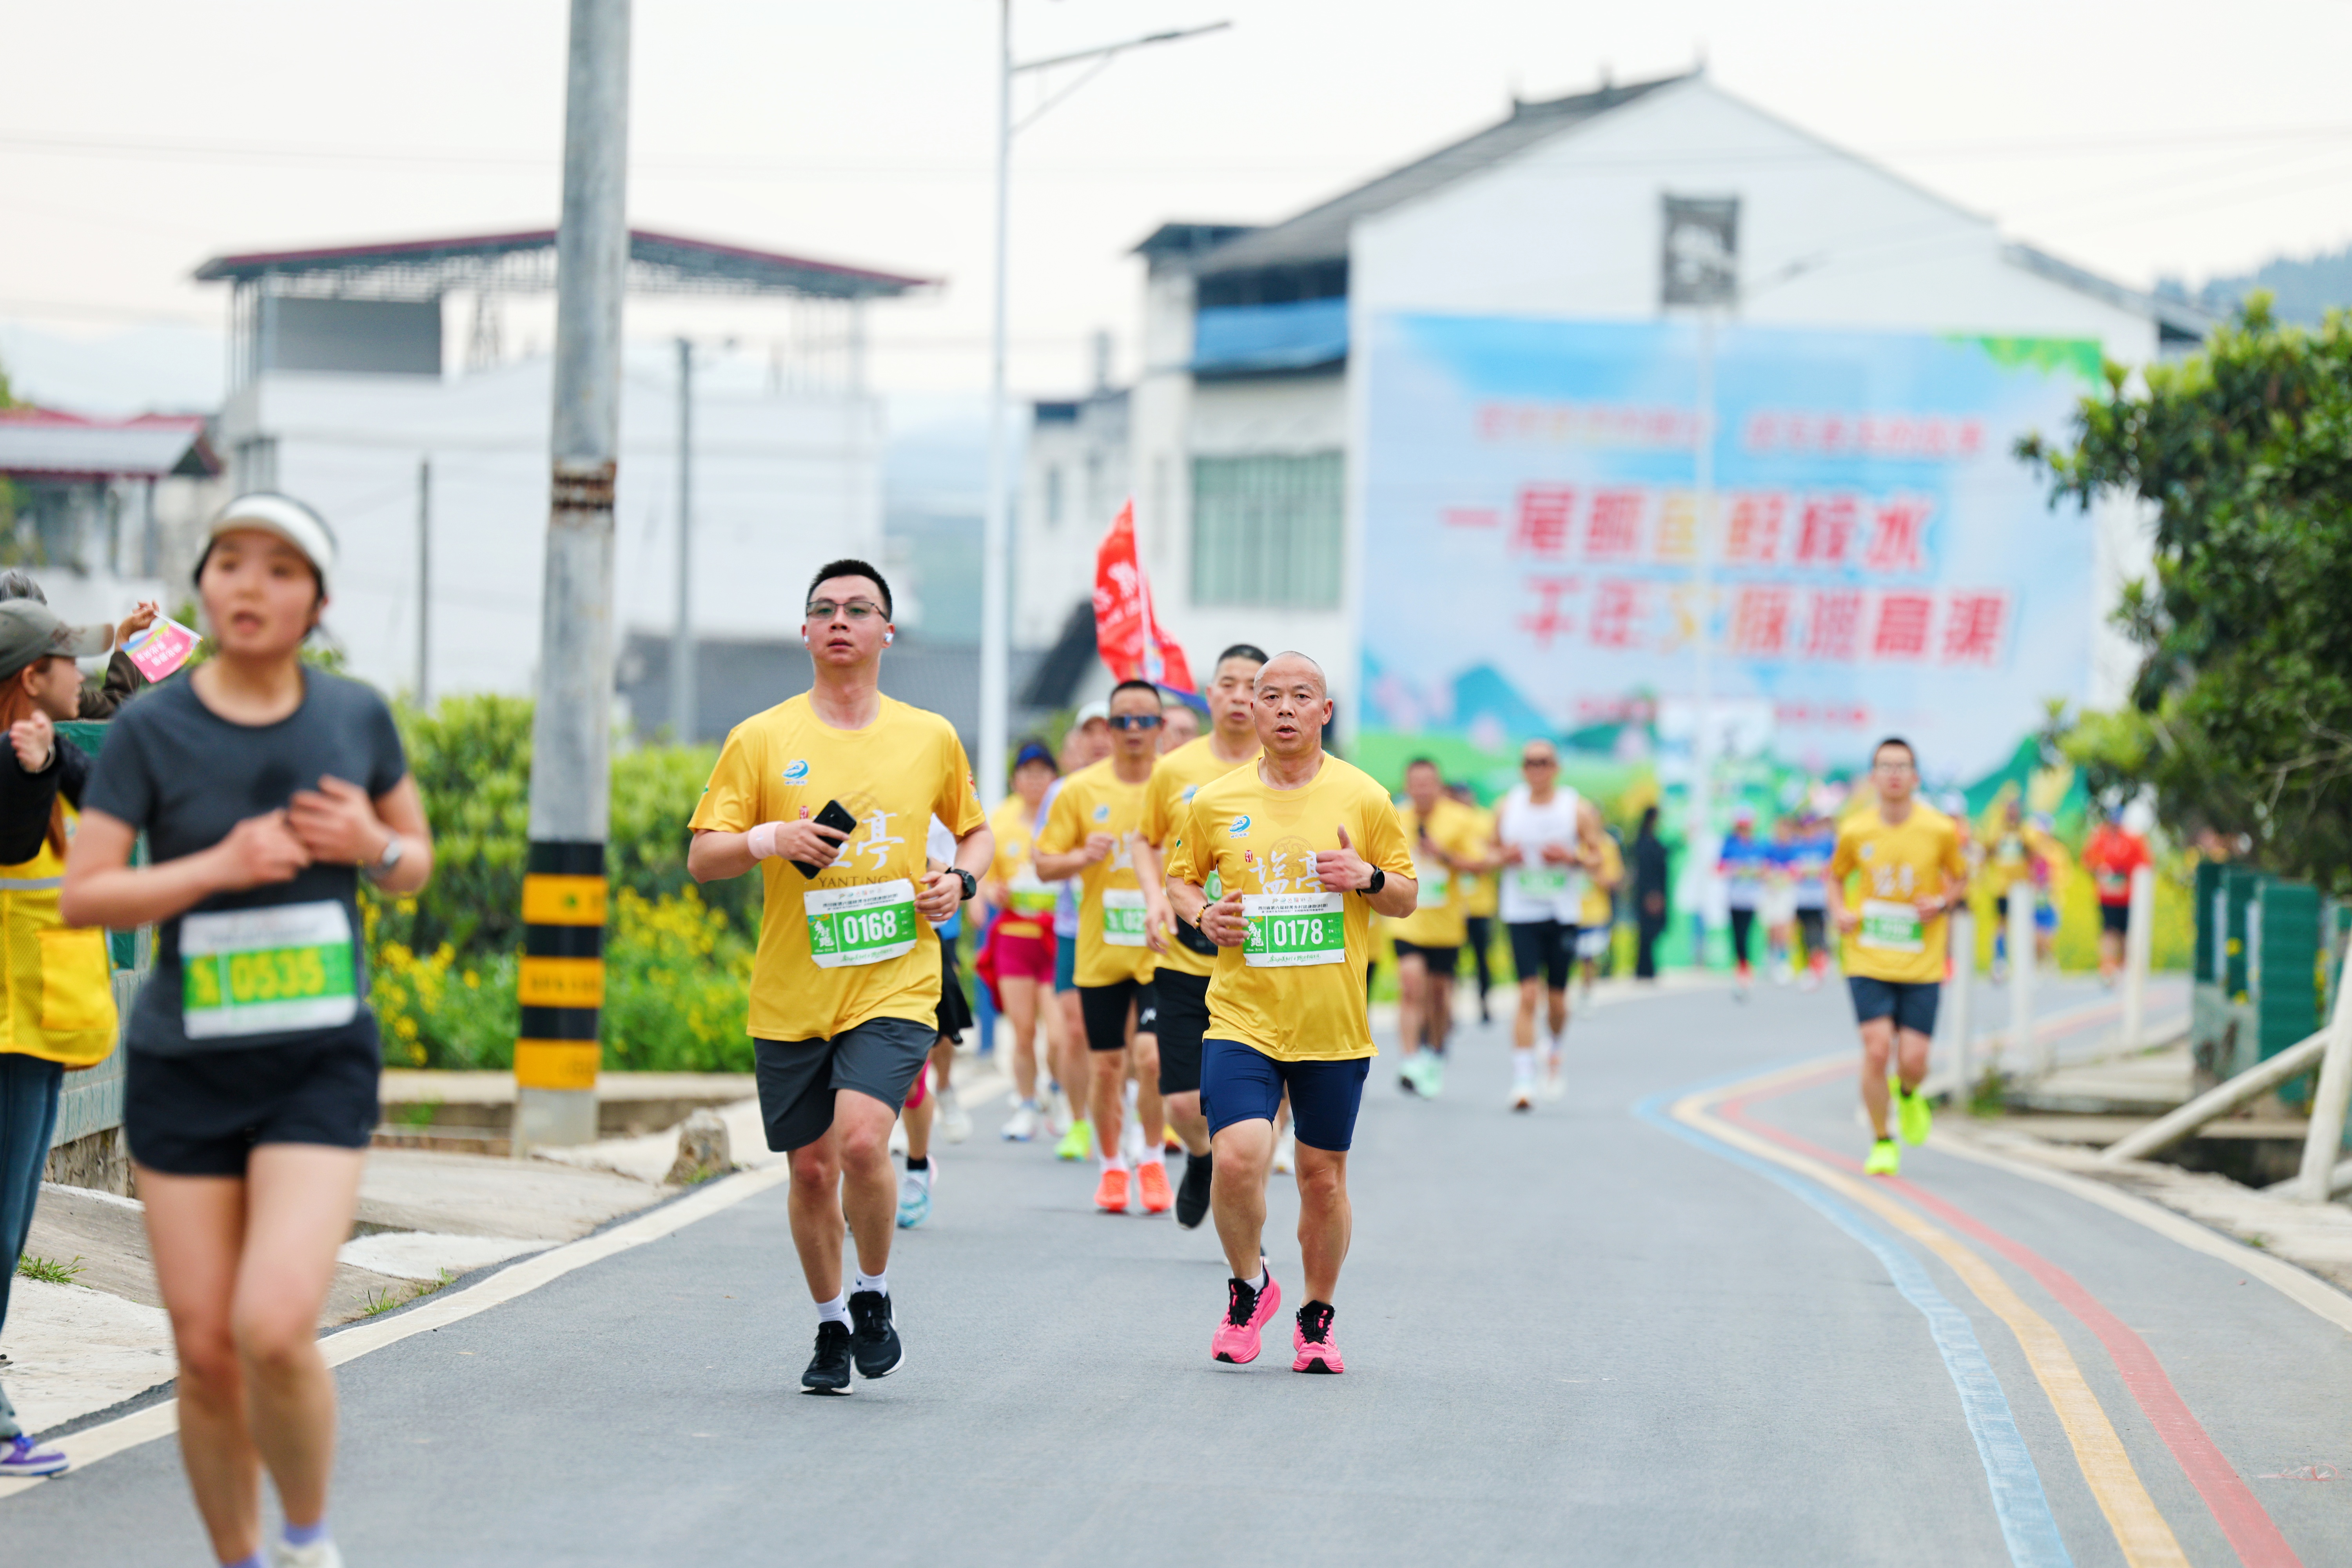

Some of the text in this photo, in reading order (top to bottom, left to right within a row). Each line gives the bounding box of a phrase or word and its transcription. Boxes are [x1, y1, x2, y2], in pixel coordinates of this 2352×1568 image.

[843, 910, 897, 944] 0168
[1274, 918, 1323, 946] 0178
[231, 946, 325, 1002] 0535
